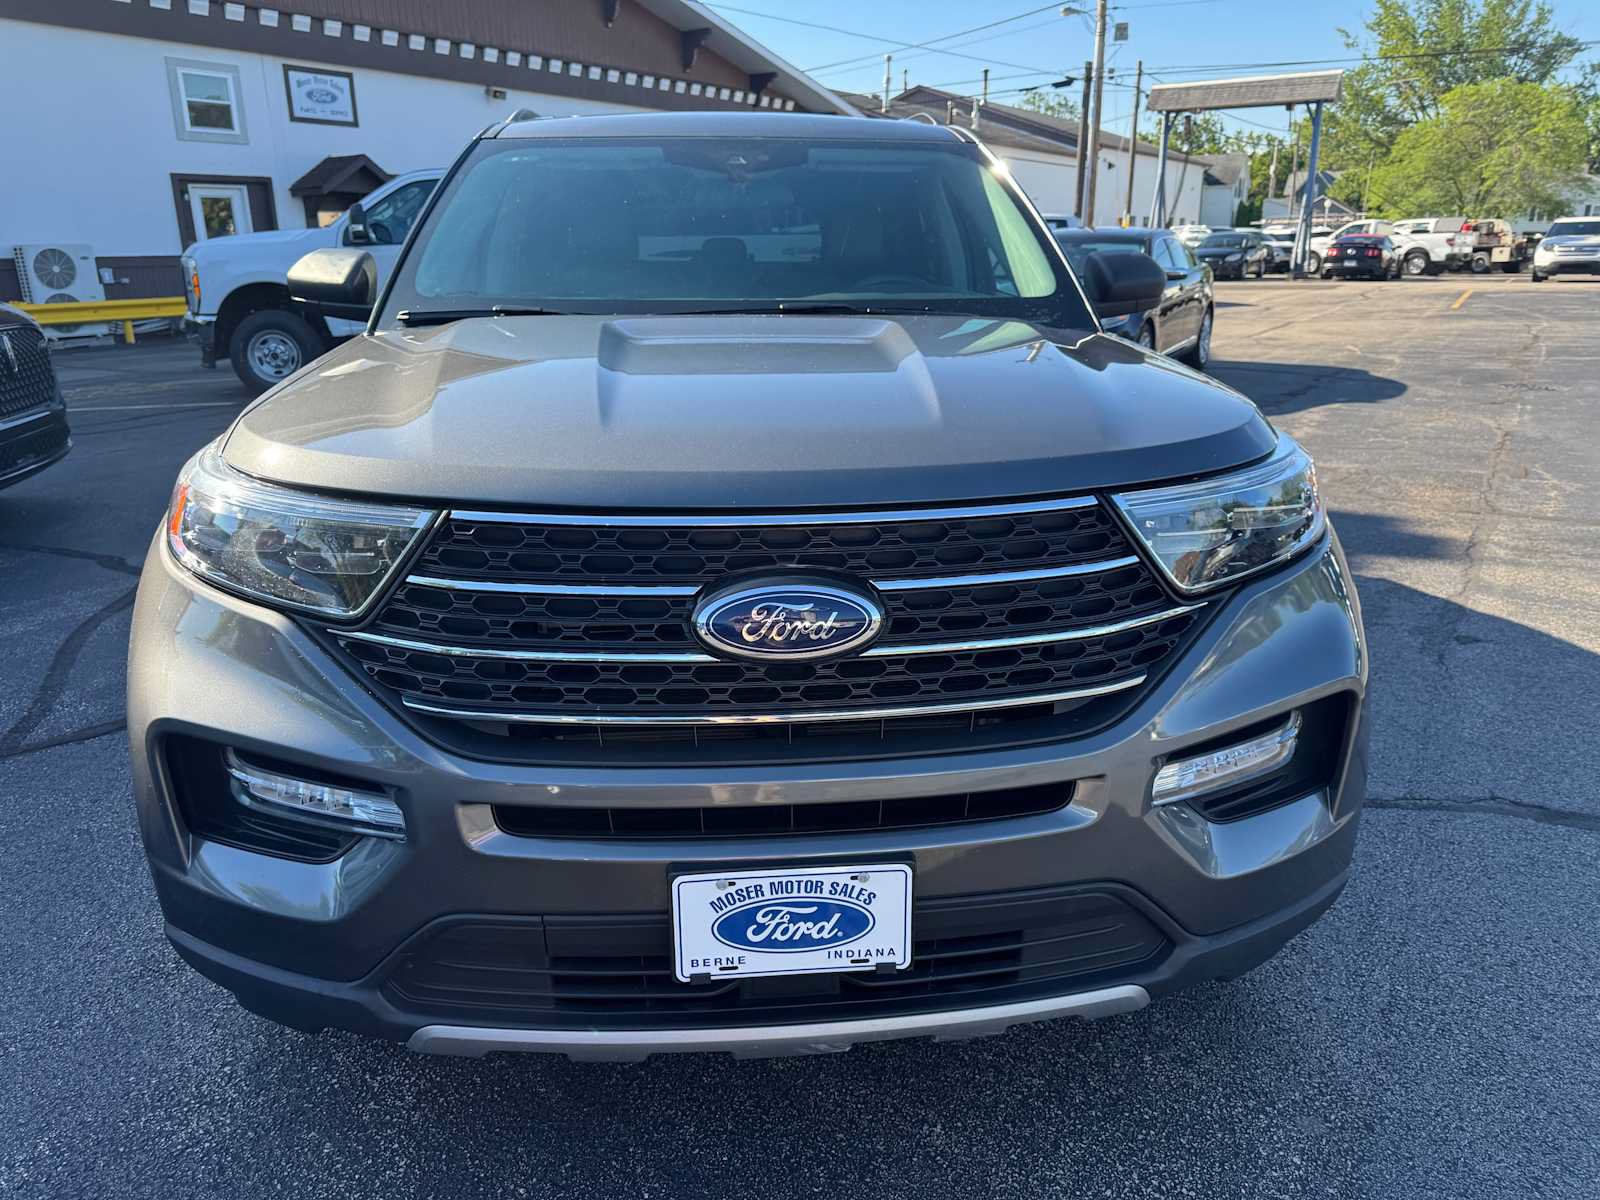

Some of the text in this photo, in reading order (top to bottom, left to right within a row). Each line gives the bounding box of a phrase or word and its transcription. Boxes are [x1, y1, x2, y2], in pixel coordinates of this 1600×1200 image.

[742, 602, 838, 642] Ford
[709, 880, 877, 914] MOSER MOTOR SALES
[746, 906, 842, 942] Ford
[690, 947, 896, 968] BERNE INDIANA
